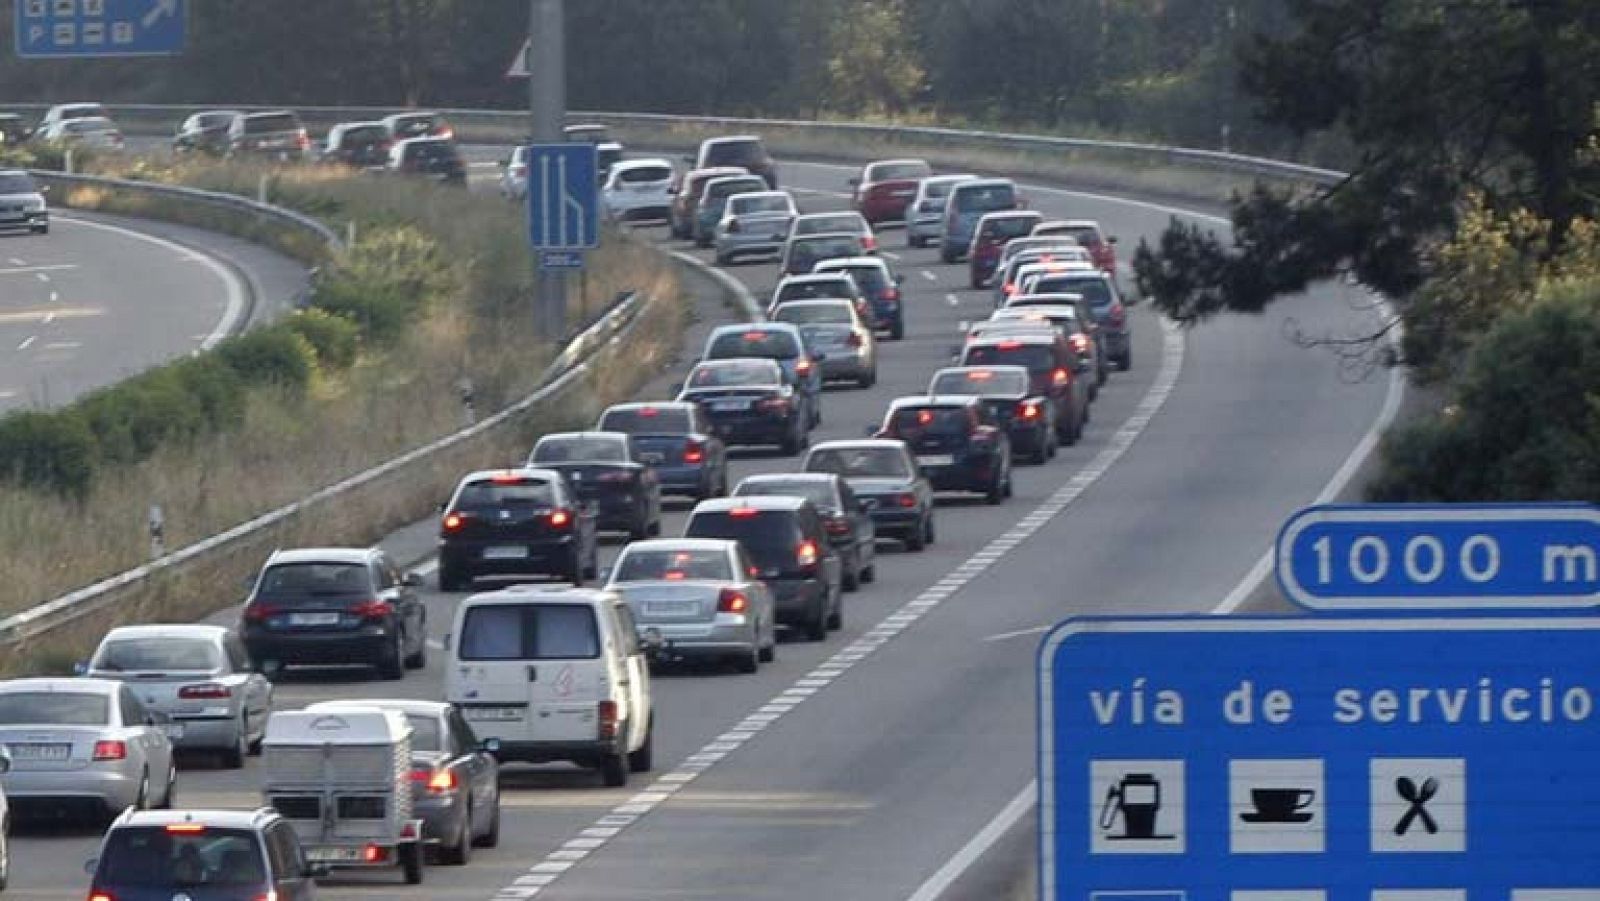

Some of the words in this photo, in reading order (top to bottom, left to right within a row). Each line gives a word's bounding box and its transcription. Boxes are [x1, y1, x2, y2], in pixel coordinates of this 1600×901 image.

[1313, 535, 1500, 584] 1000
[1543, 544, 1597, 583] m
[1090, 679, 1183, 724] vía
[1223, 681, 1293, 724] de
[1334, 678, 1592, 723] servicio
